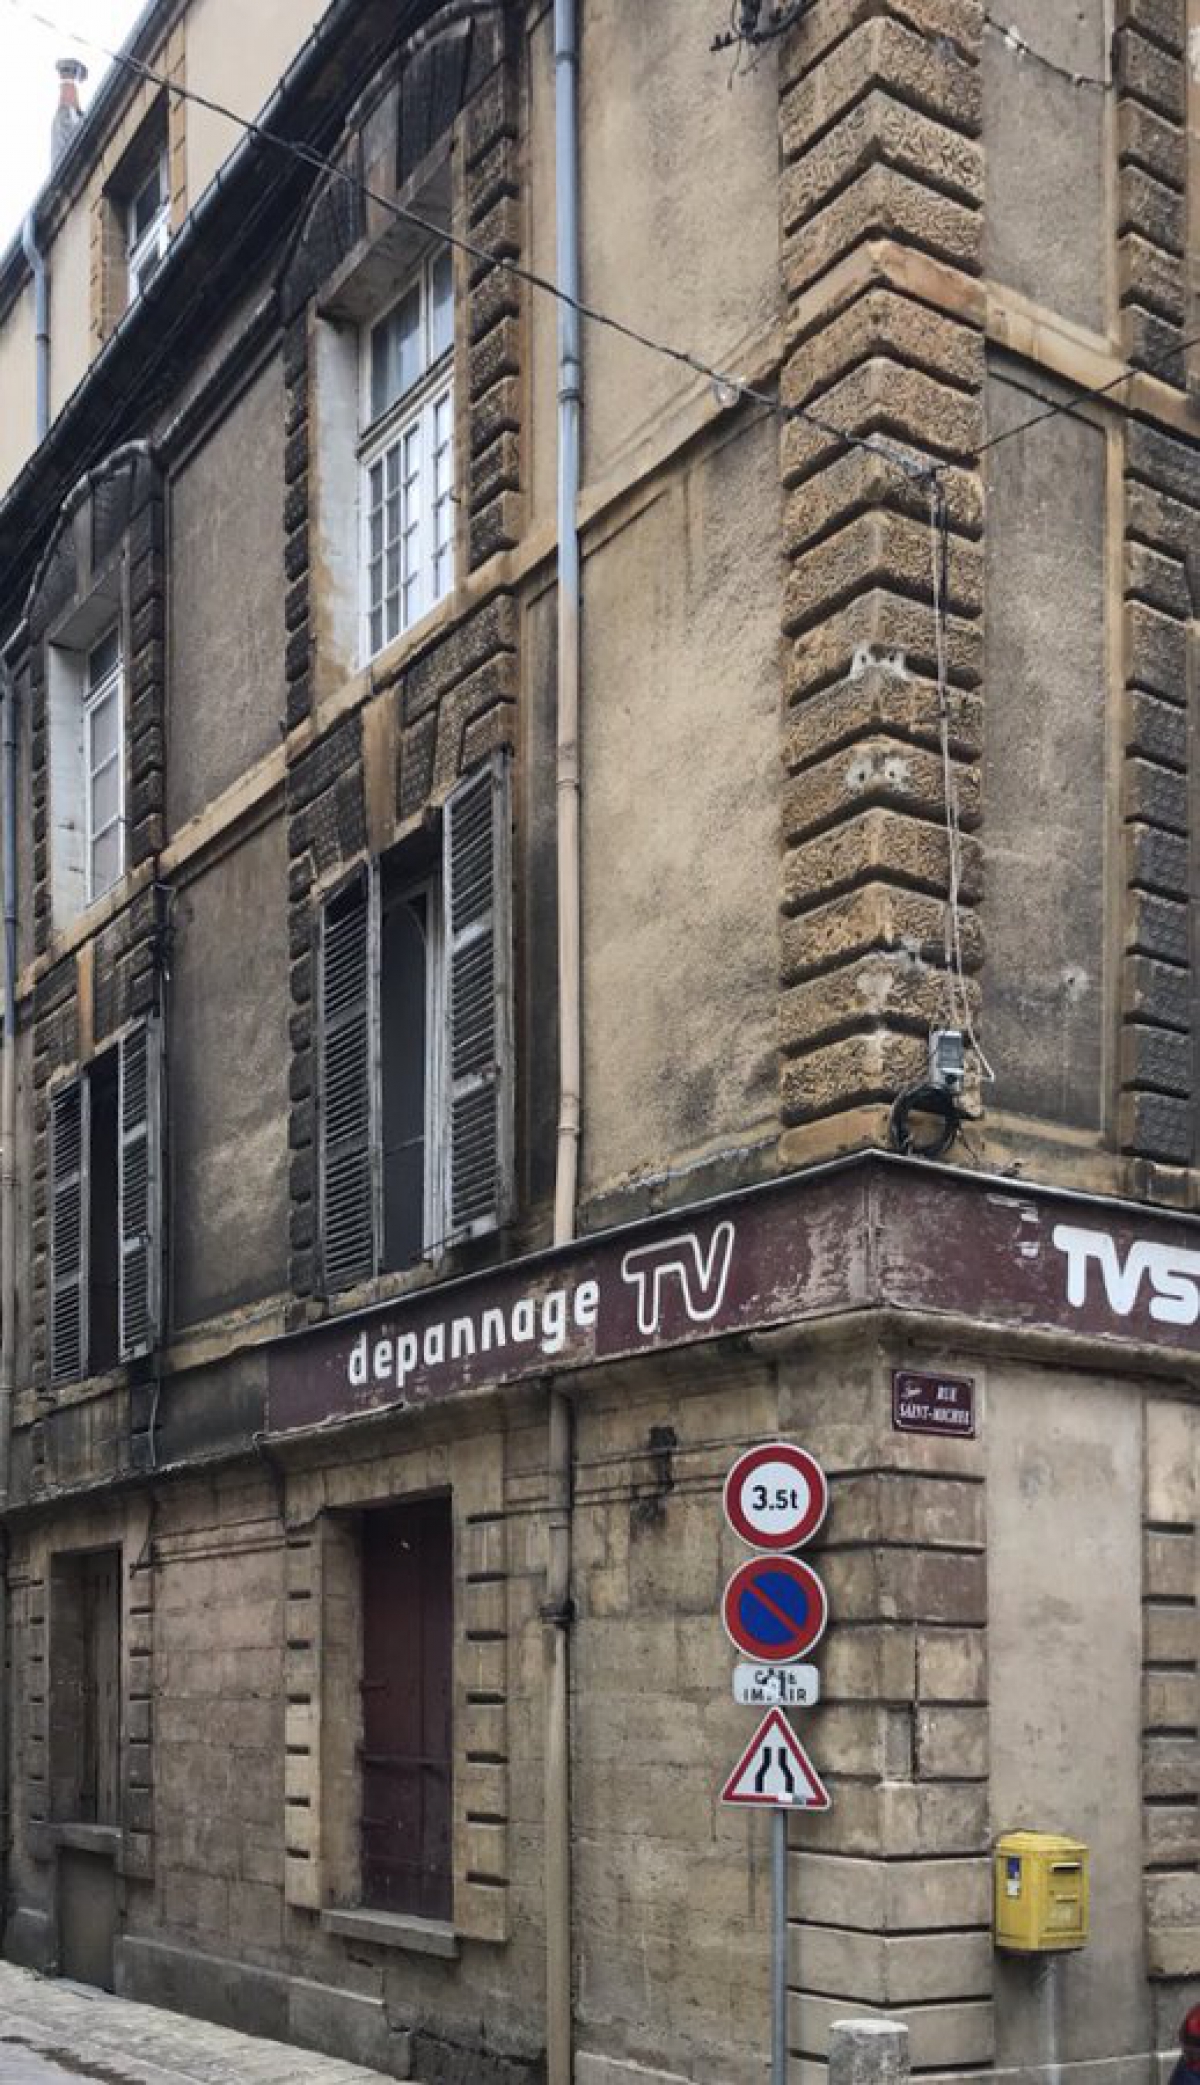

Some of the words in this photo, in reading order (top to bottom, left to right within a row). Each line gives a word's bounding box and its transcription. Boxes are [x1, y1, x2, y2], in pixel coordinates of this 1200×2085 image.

[622, 1222, 735, 1335] TV
[1053, 1225, 1200, 1325] TVS
[753, 1485, 798, 1511] 3.5t
